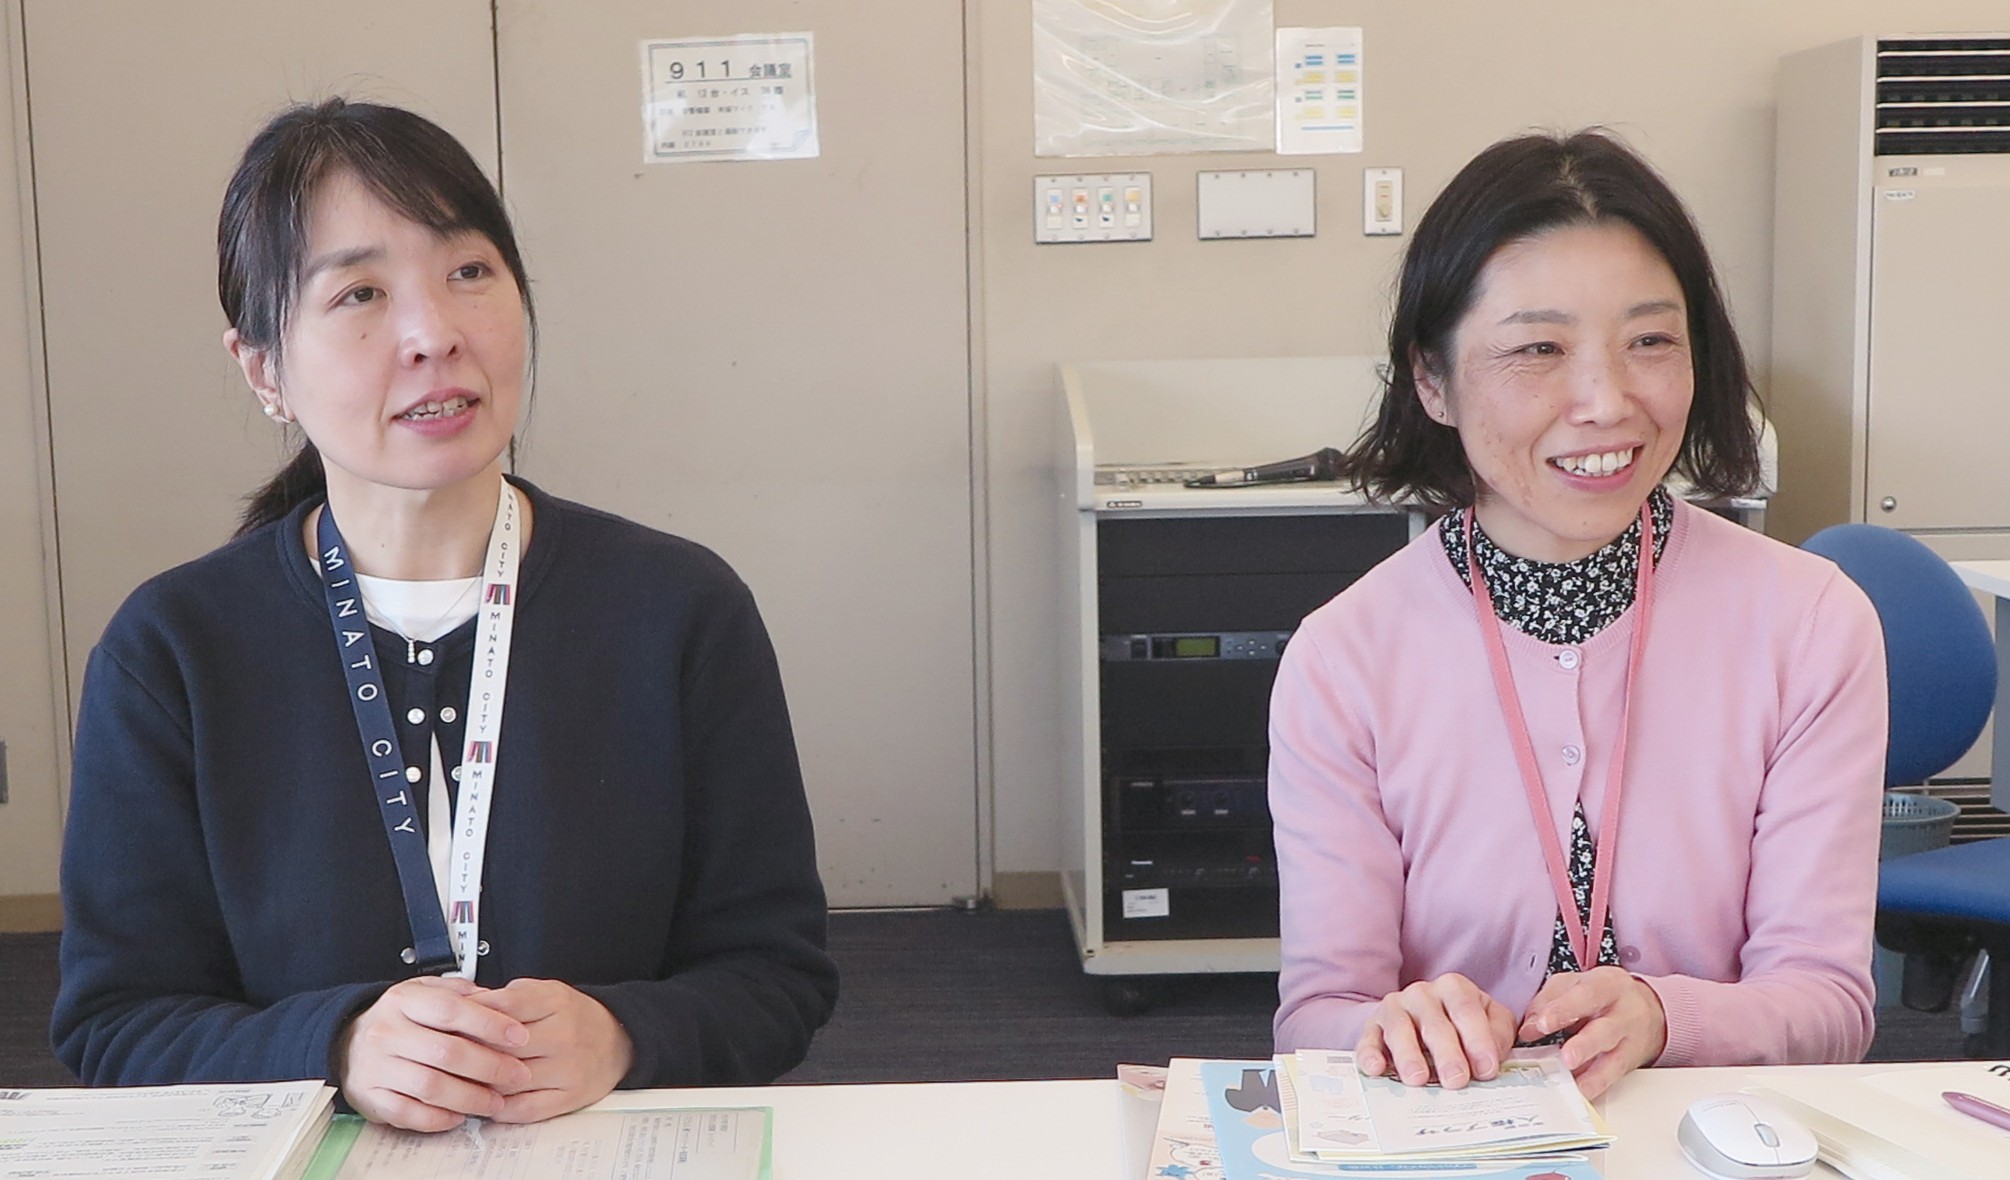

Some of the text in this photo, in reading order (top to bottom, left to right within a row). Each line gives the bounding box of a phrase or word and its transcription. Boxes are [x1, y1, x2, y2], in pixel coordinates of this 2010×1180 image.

[669, 59, 793, 80] 911 会議室
[497, 542, 509, 578] CITY
[323, 545, 416, 834] MINATO CITY
[479, 611, 501, 733] MINATO CITY
[460, 769, 483, 894] MINATO CITY
